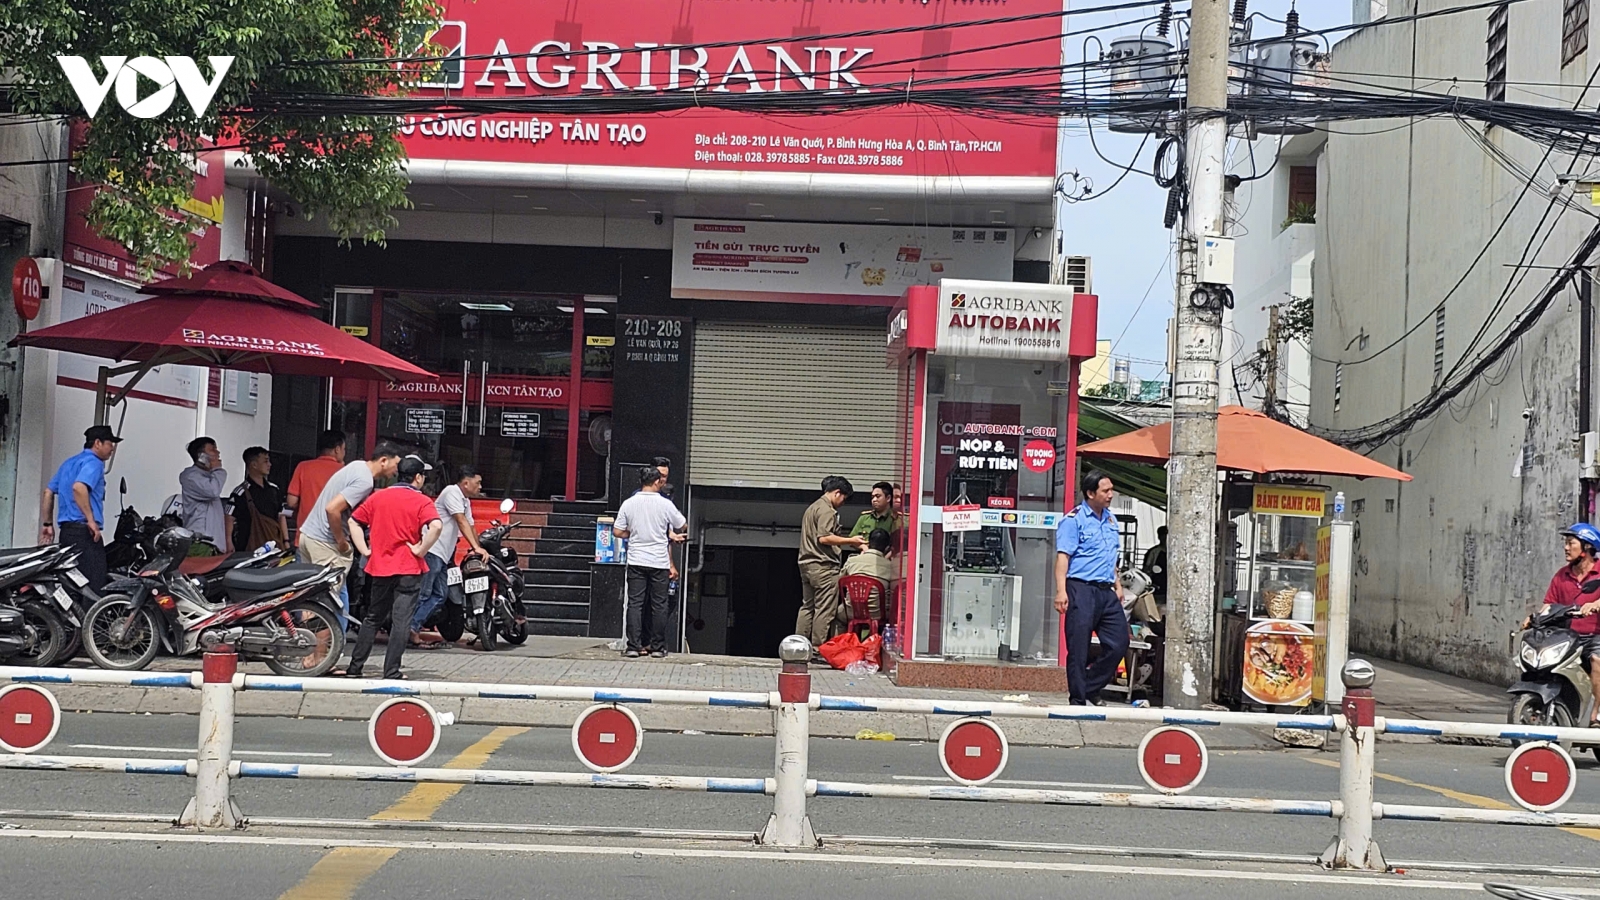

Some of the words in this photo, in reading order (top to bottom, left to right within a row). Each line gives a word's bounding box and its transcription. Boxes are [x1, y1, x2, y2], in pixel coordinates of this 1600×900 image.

[474, 38, 874, 95] AGRIBANK
[420, 113, 476, 138] CÔNG
[481, 117, 553, 143] NGHIỆP
[559, 119, 600, 142] TÂN
[606, 123, 647, 146] TẠO
[695, 134, 710, 147] Địa
[712, 132, 728, 145] chỉ:
[730, 135, 767, 147] 208-210
[769, 136, 781, 147] Lê
[783, 136, 800, 147] Văn
[827, 138, 835, 148] P.
[837, 137, 856, 148] Bình
[858, 138, 882, 152] Hưng
[885, 138, 903, 150] Hòa
[905, 139, 915, 152] A,
[917, 139, 926, 151] Q.
[928, 139, 948, 151] Bình
[695, 150, 715, 163] Điện
[717, 151, 743, 164] thoại:
[745, 152, 765, 163] 028.
[817, 154, 836, 164] Fax:
[880, 155, 903, 166] 5886
[748, 244, 780, 254] TRỰC
[968, 296, 1063, 313] AGRIBANK
[948, 313, 1062, 333] AUTOBANK
[207, 333, 324, 351] AGRIBANK
[398, 382, 463, 394] AGRIBANK
[486, 385, 511, 396] KCN
[513, 384, 539, 397] TÂN
[540, 387, 562, 399] TẠO
[964, 423, 1025, 436] AUTOBANK
[960, 438, 992, 453] NỘP
[993, 440, 1005, 453] &
[959, 455, 987, 469] RÚT
[1002, 498, 1011, 506] RA
[1256, 490, 1279, 509] BÁNH
[1281, 494, 1304, 511] CANH
[1305, 496, 1321, 512] CUA
